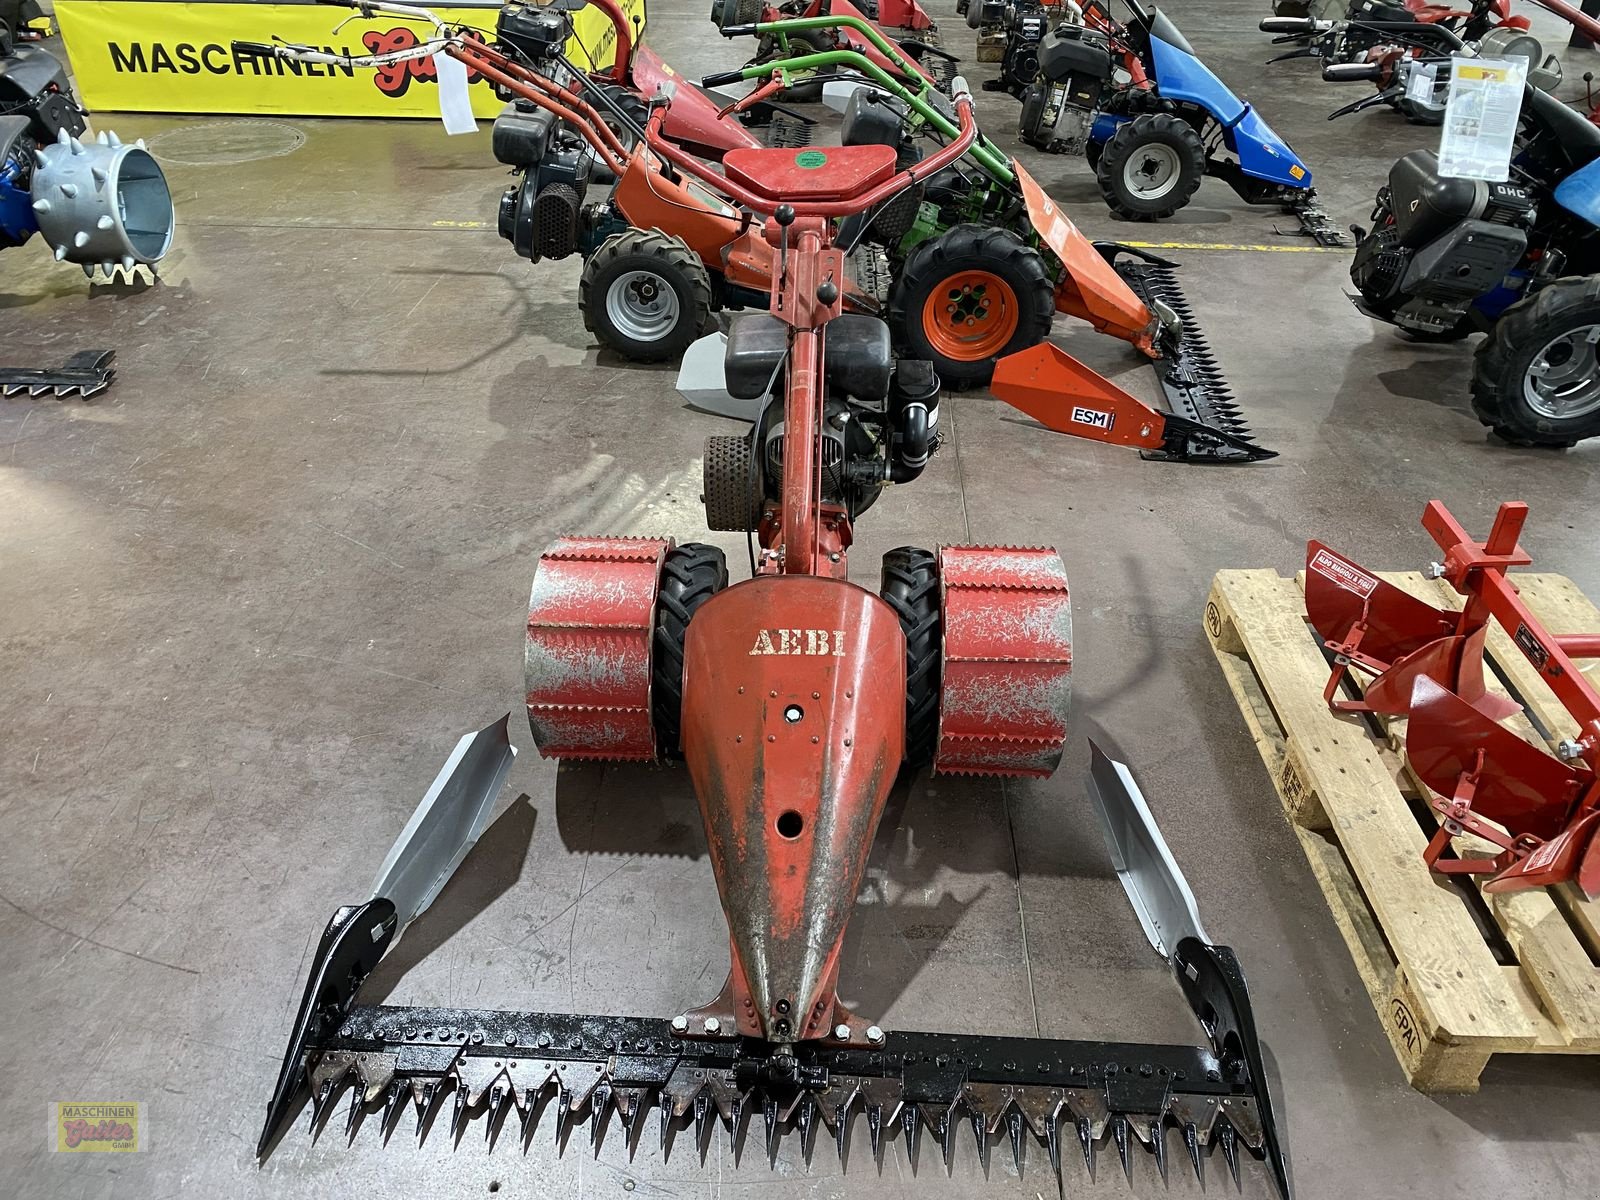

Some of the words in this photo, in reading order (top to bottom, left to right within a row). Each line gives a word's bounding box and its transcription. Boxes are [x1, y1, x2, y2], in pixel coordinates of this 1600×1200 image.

[1497, 185, 1526, 198] OHC
[1073, 408, 1107, 427] ESM
[1318, 555, 1333, 567] ALDO
[1331, 562, 1354, 581] BIAGIOLI
[1357, 578, 1372, 590] FIGLI
[748, 629, 847, 657] AEBI
[1394, 1006, 1417, 1056] EPAL
